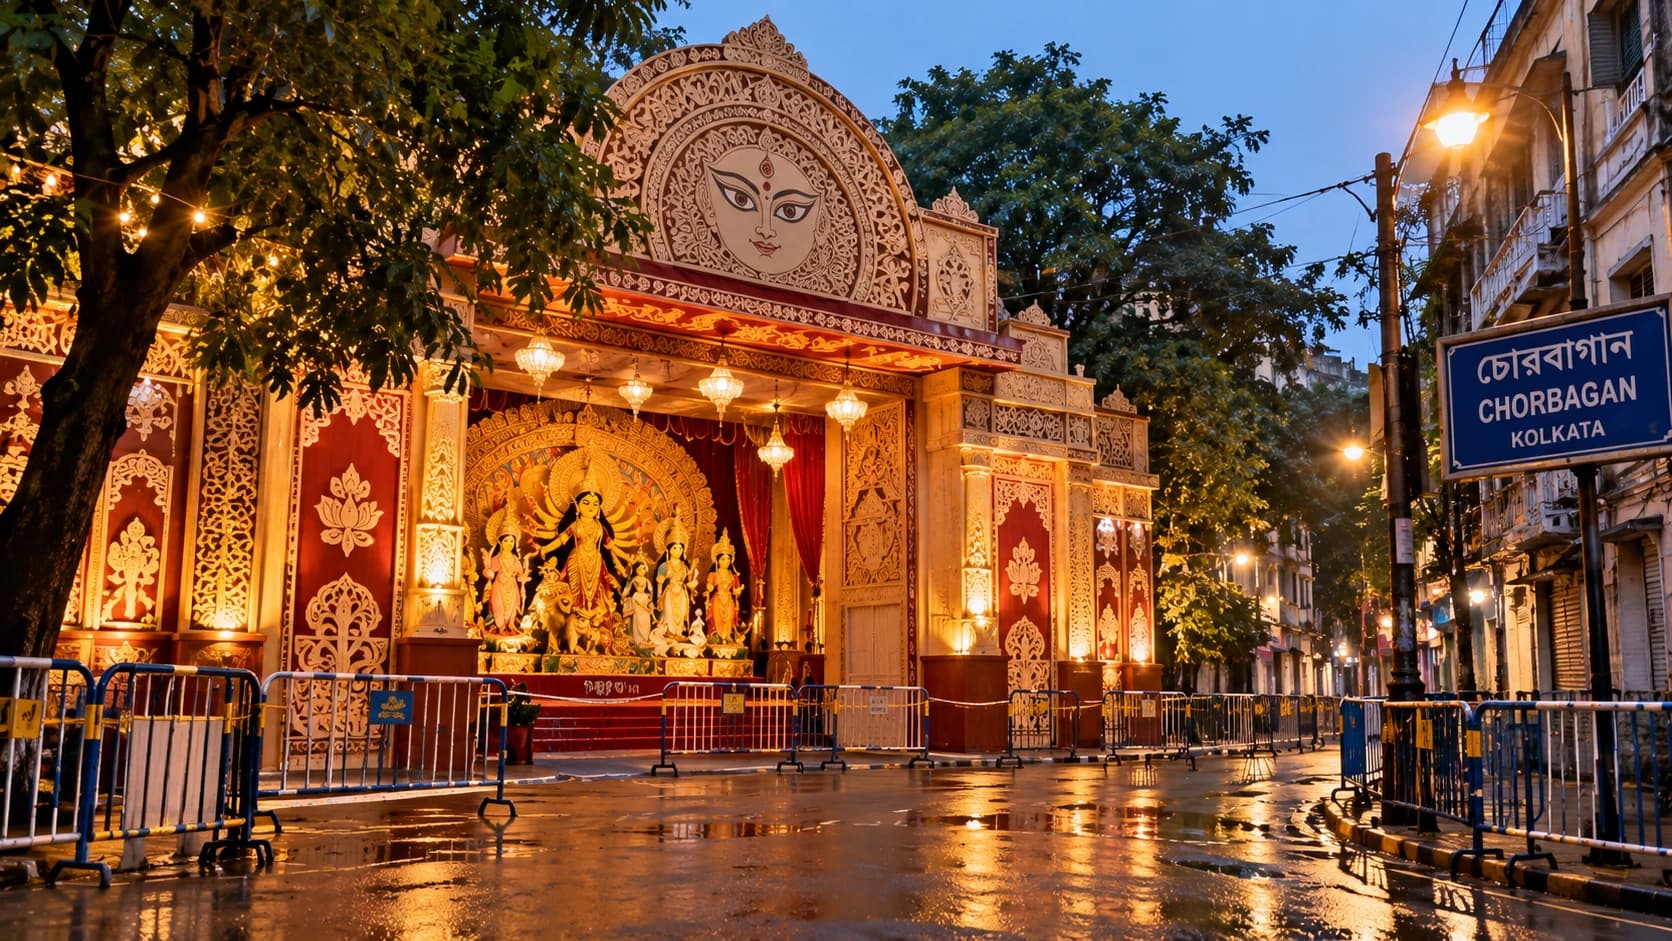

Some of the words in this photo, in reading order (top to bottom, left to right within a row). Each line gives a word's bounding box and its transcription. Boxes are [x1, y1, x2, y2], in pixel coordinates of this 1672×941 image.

[1477, 330, 1634, 384] চোরবাগান
[1478, 375, 1637, 424] CHORBAGAN
[1511, 419, 1606, 449] KOLKATA
